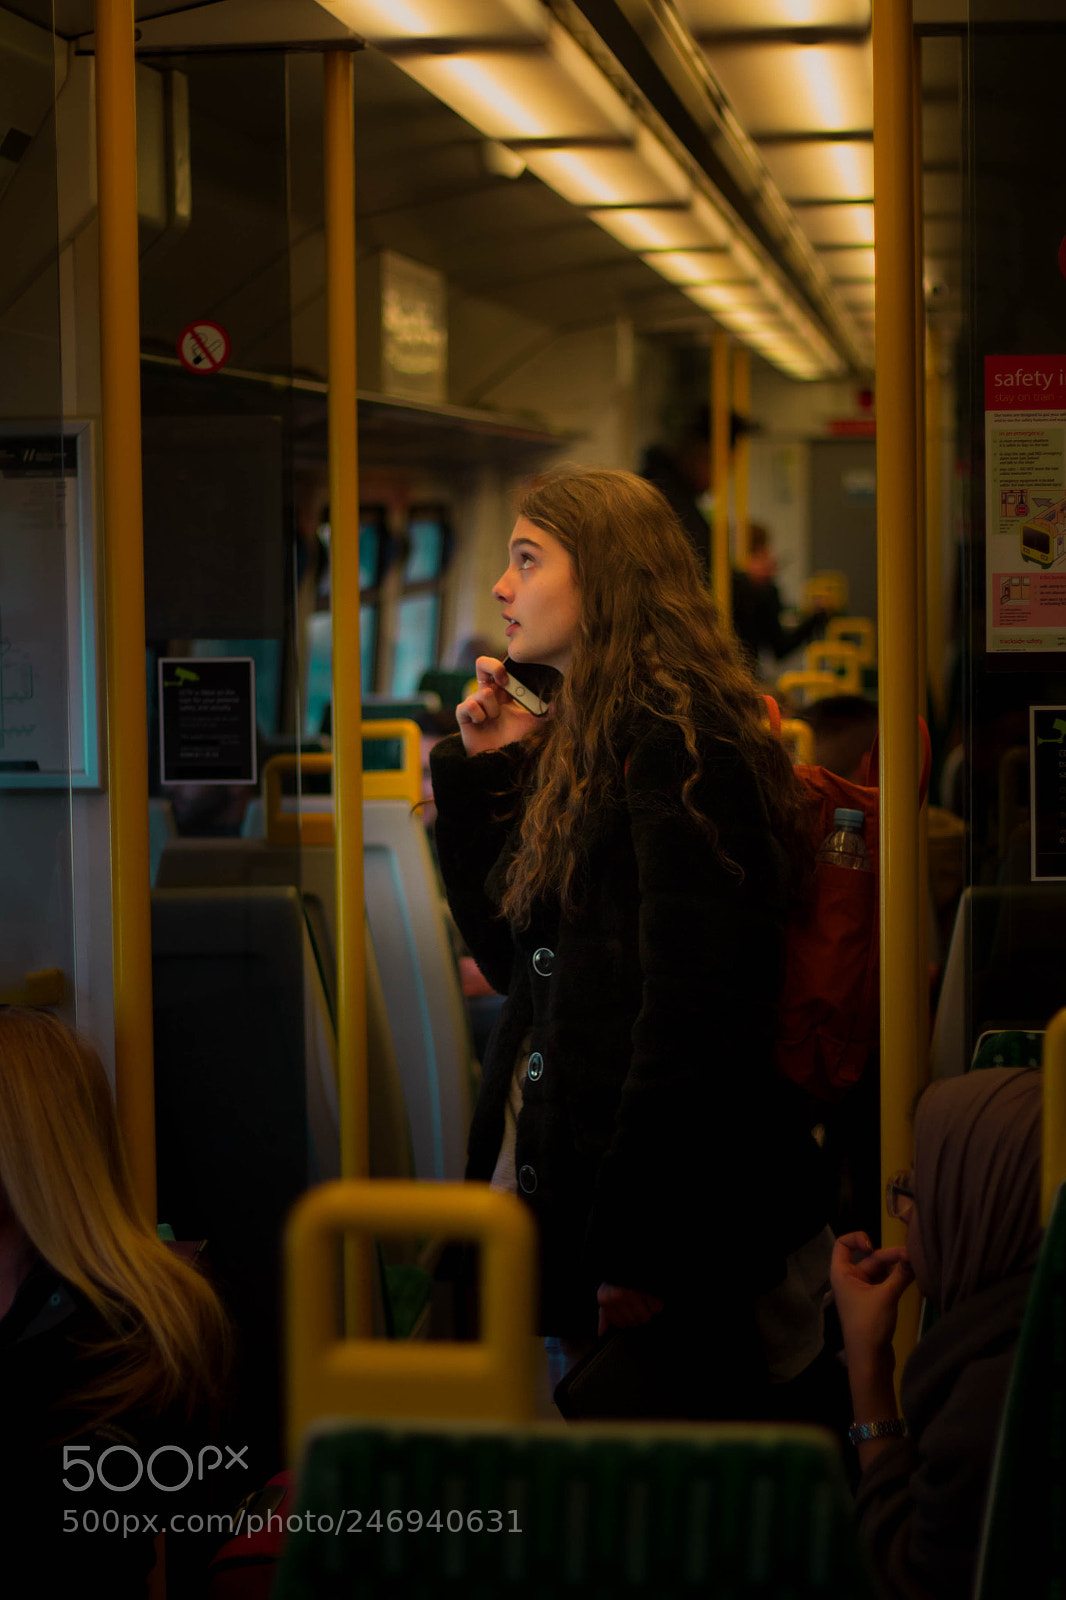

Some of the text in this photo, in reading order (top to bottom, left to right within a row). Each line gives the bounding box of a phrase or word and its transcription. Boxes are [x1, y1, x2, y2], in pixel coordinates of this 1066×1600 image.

[994, 369, 1053, 391] safety
[994, 392, 1014, 404] stay
[1017, 393, 1031, 402] on
[1033, 392, 1055, 401] train
